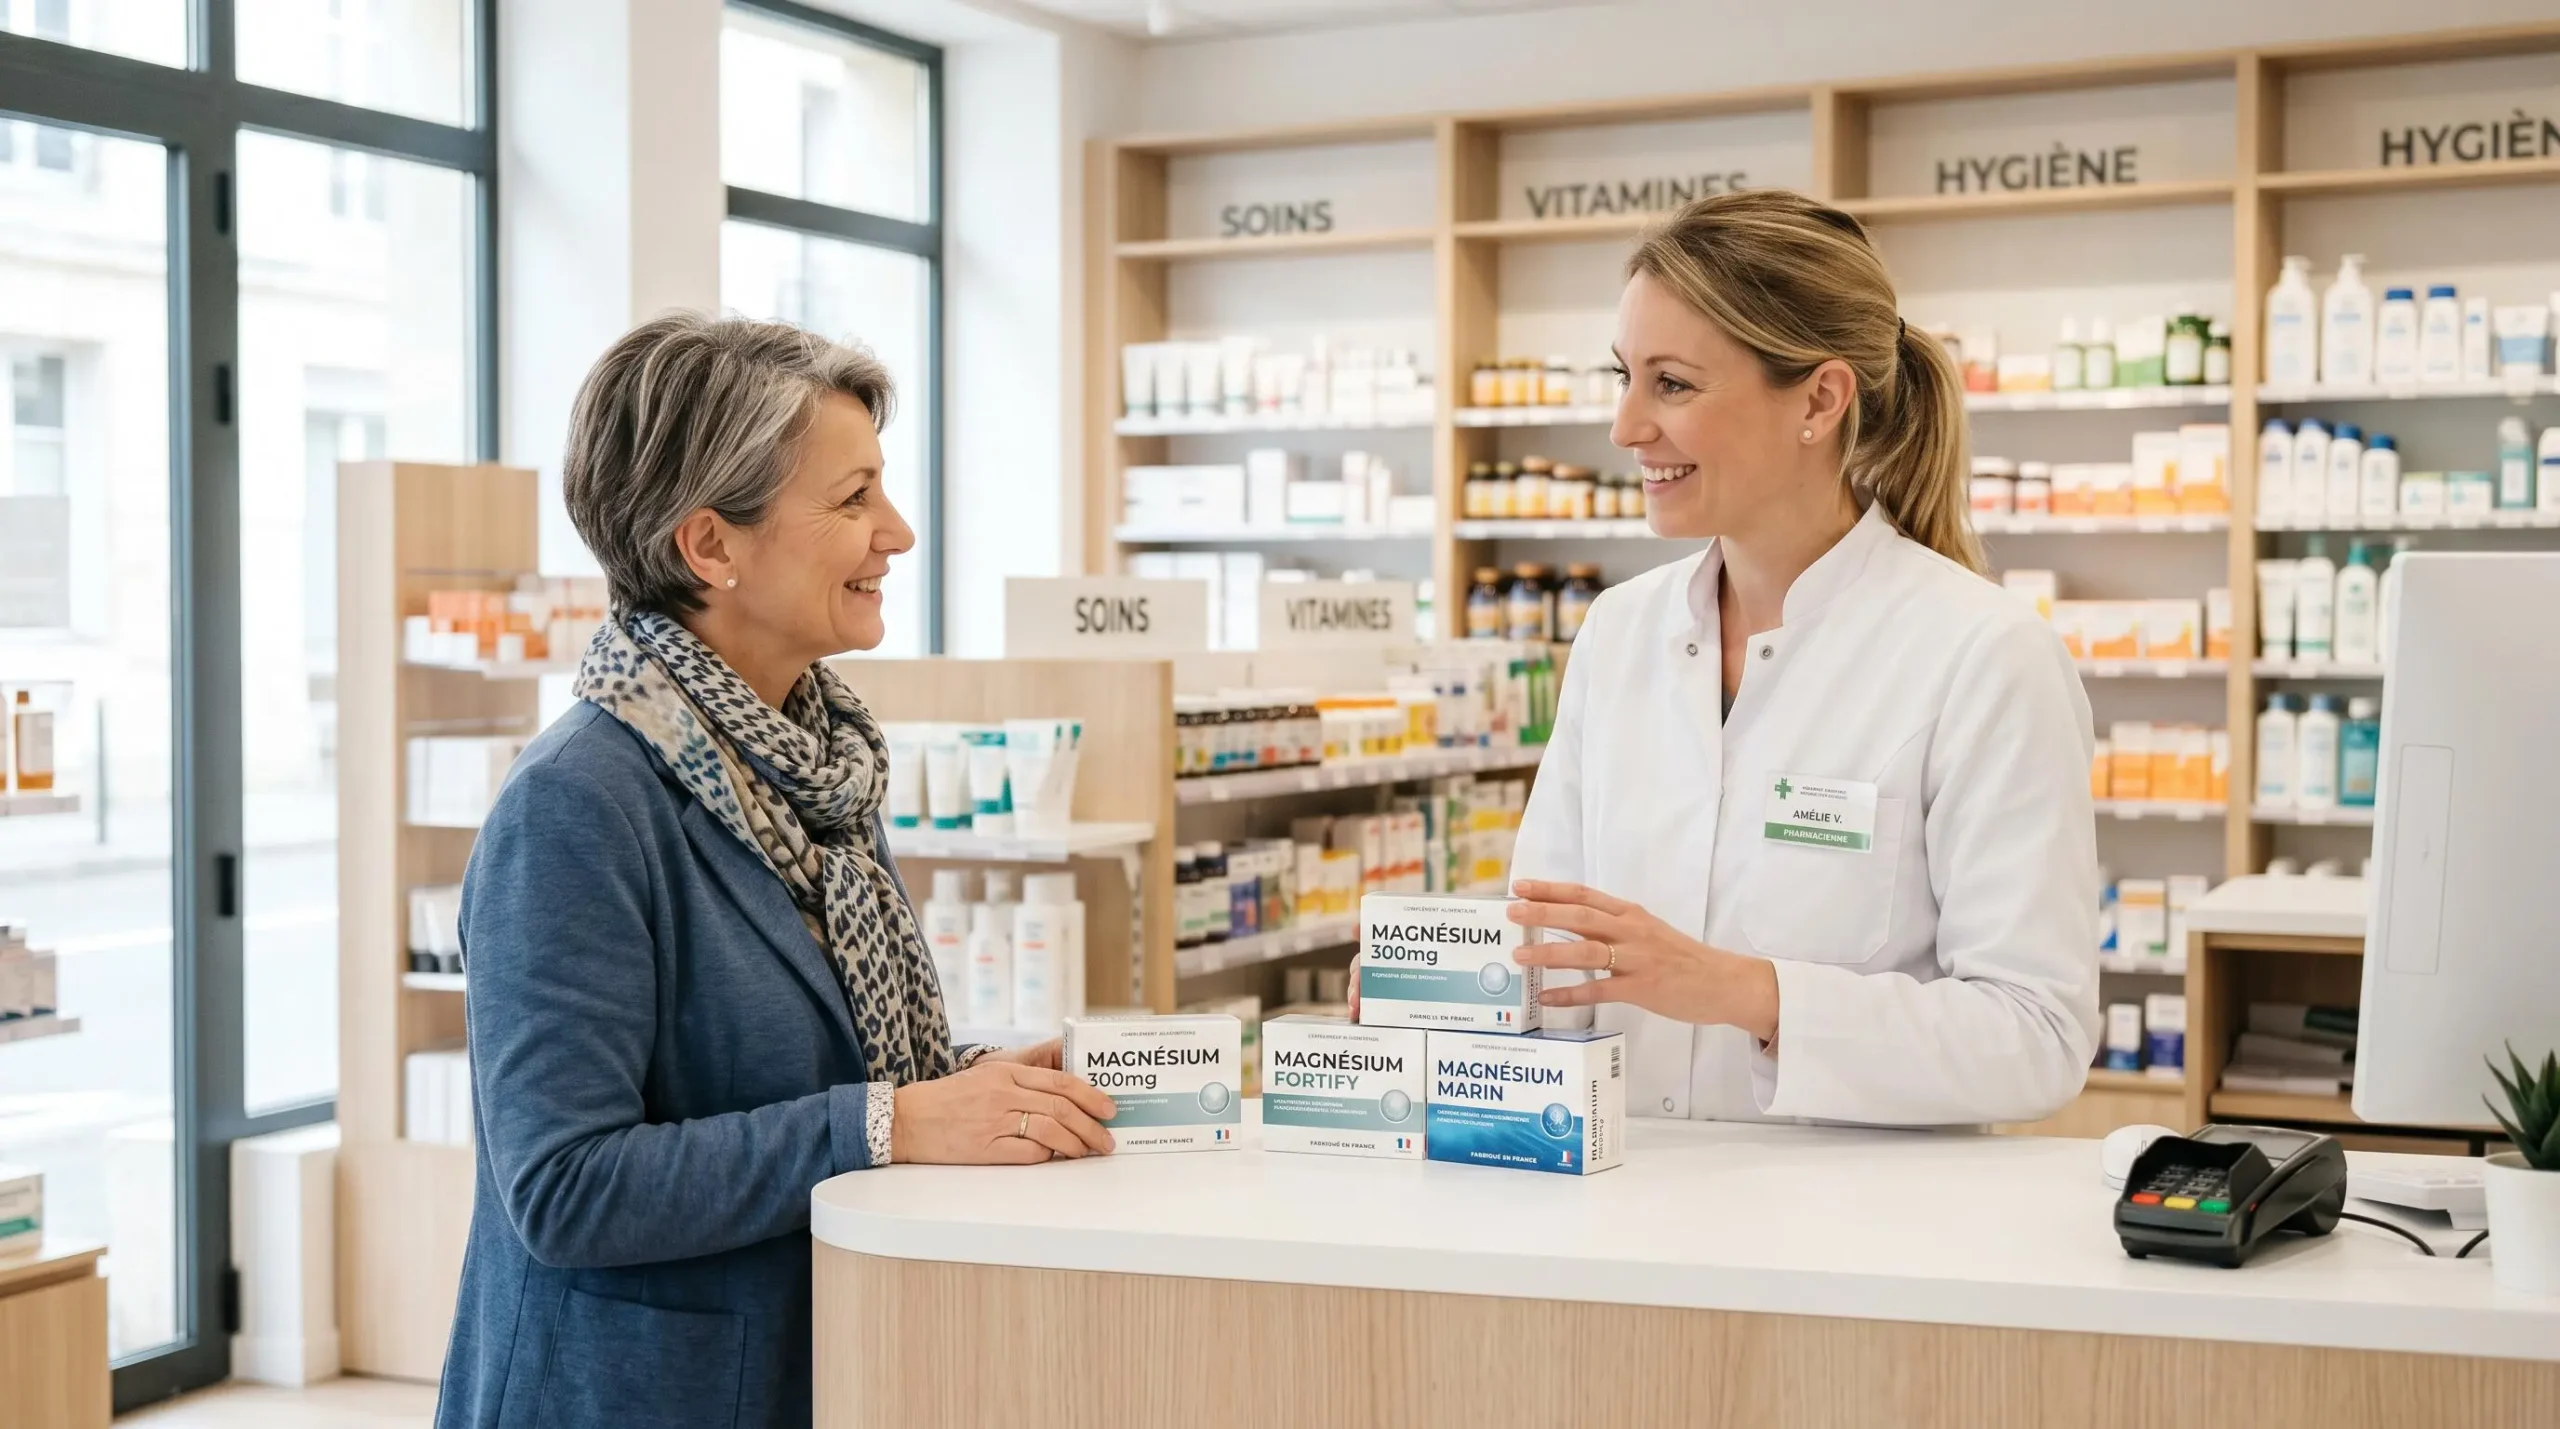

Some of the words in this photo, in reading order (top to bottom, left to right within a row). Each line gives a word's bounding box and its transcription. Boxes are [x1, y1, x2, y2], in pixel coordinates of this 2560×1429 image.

[1935, 141, 2139, 194] HYGIÈNE
[1220, 201, 1333, 237] SOINS
[1074, 597, 1149, 634] SOINS
[1285, 597, 1392, 632] VITAMINES
[1793, 809, 1831, 822] AMÉLIE
[1833, 813, 1843, 824] V.
[1371, 923, 1501, 945] MAGNÉSIUM
[1371, 944, 1439, 966] 300mg
[1087, 1046, 1220, 1068] MAGNÉSIUM
[1274, 1050, 1403, 1073] MAGNÉSIUM
[1088, 1072, 1157, 1090] 300mg
[1274, 1071, 1360, 1091] FORTIFY
[1437, 1060, 1564, 1086] MAGNÉSIUM
[1437, 1081, 1504, 1102] MARIN
